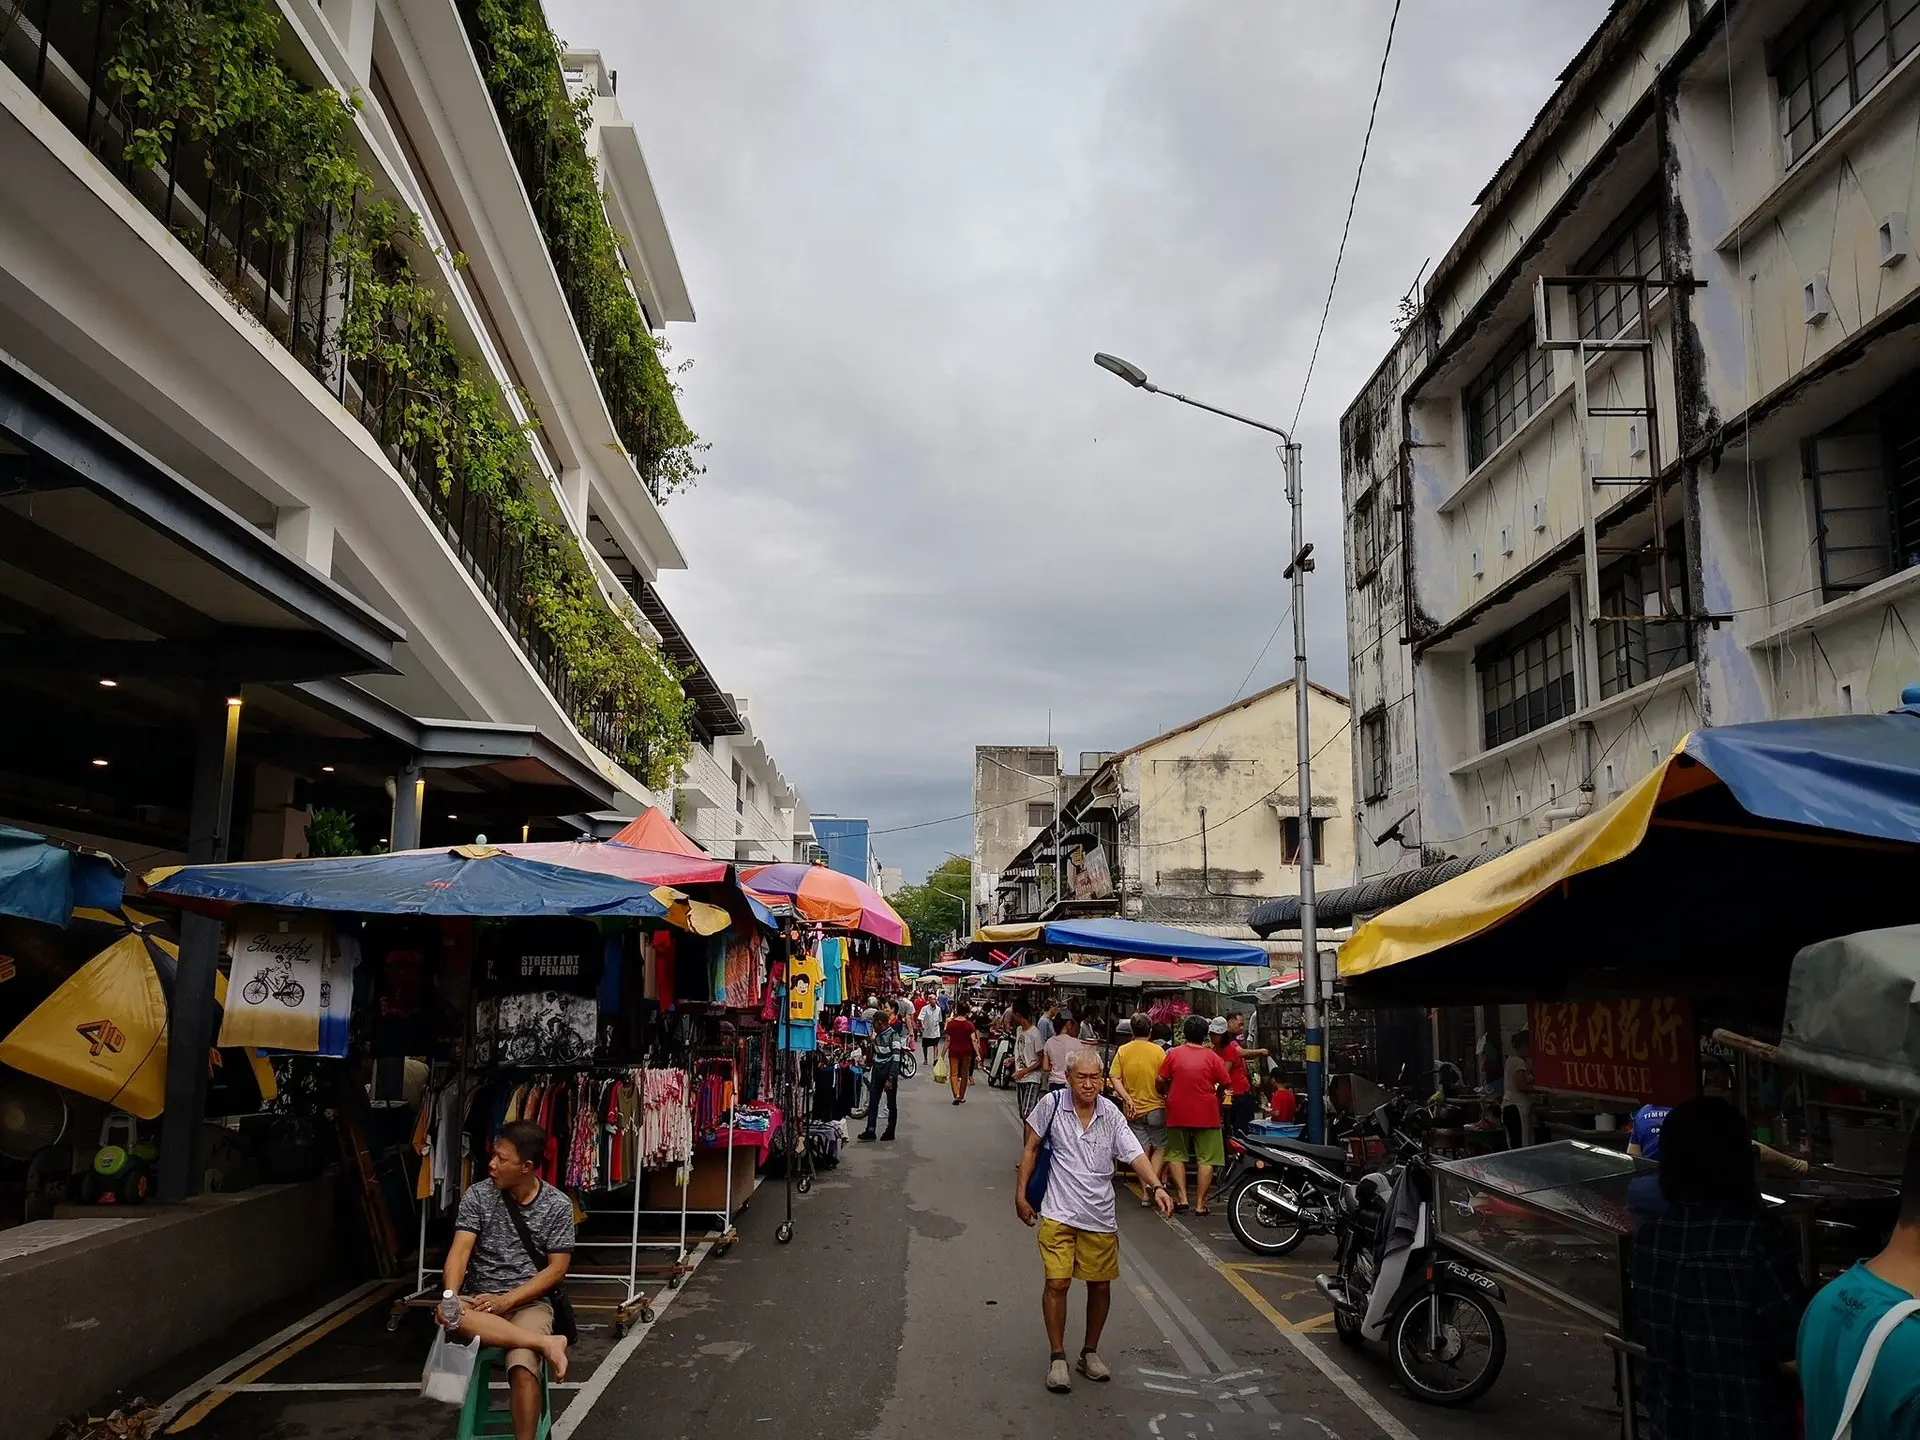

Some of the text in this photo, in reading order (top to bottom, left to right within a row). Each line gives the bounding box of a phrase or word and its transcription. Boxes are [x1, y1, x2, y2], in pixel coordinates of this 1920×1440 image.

[521, 955, 580, 966] STREET ART
[520, 965, 579, 976] OF PENANG
[1562, 1061, 1653, 1094] TUCK KEE
[1447, 1262, 1496, 1289] PES 4737
